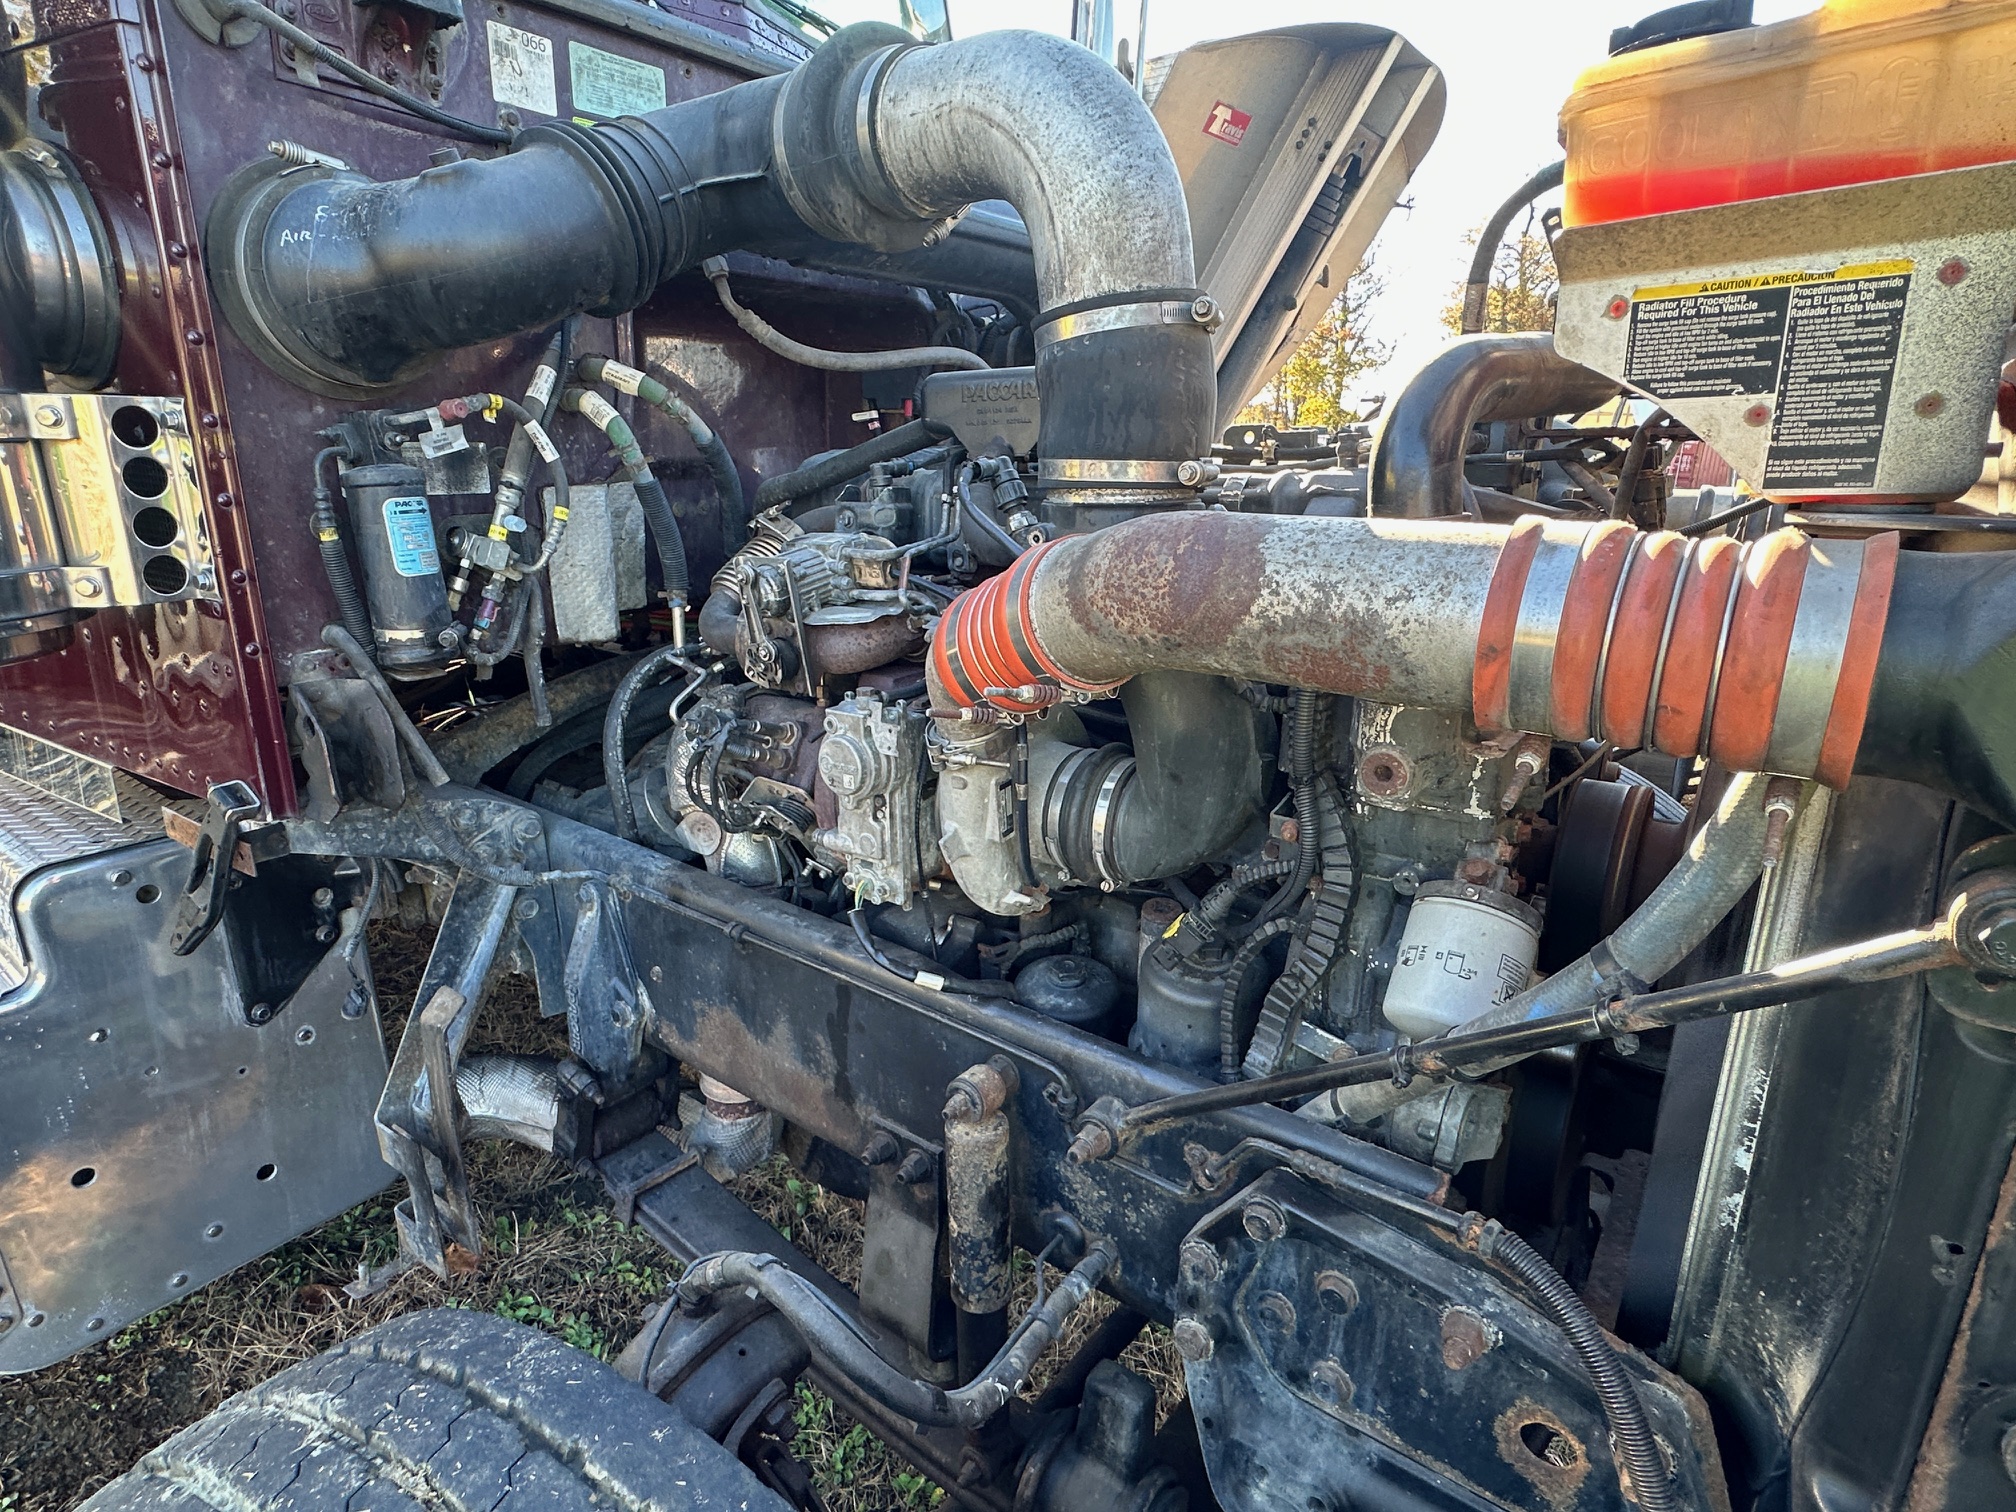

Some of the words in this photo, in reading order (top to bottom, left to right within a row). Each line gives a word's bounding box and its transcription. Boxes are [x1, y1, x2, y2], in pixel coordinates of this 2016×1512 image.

[521, 32, 547, 53] 066
[1208, 104, 1245, 139] Travis
[1710, 278, 1751, 291] CAUTION
[1793, 281, 1856, 297] Procedimiento
[1857, 275, 1904, 292] Requerido
[1638, 299, 1677, 312] Radiator
[1680, 298, 1694, 308] Fill
[1697, 293, 1747, 306] Procedure
[1789, 305, 1829, 318] Radiador
[1830, 304, 1842, 314] En
[1843, 302, 1863, 313] Este
[1864, 296, 1904, 310] Vehículo
[1791, 296, 1811, 308] Para
[1813, 295, 1822, 305] El
[1823, 291, 1858, 304] Llenado
[1859, 289, 1875, 301] Del
[1637, 308, 1679, 321] Required
[1681, 306, 1697, 316] For
[1699, 304, 1720, 314] This
[1722, 300, 1758, 312] Vehicle
[962, 379, 1037, 403] PACCAR
